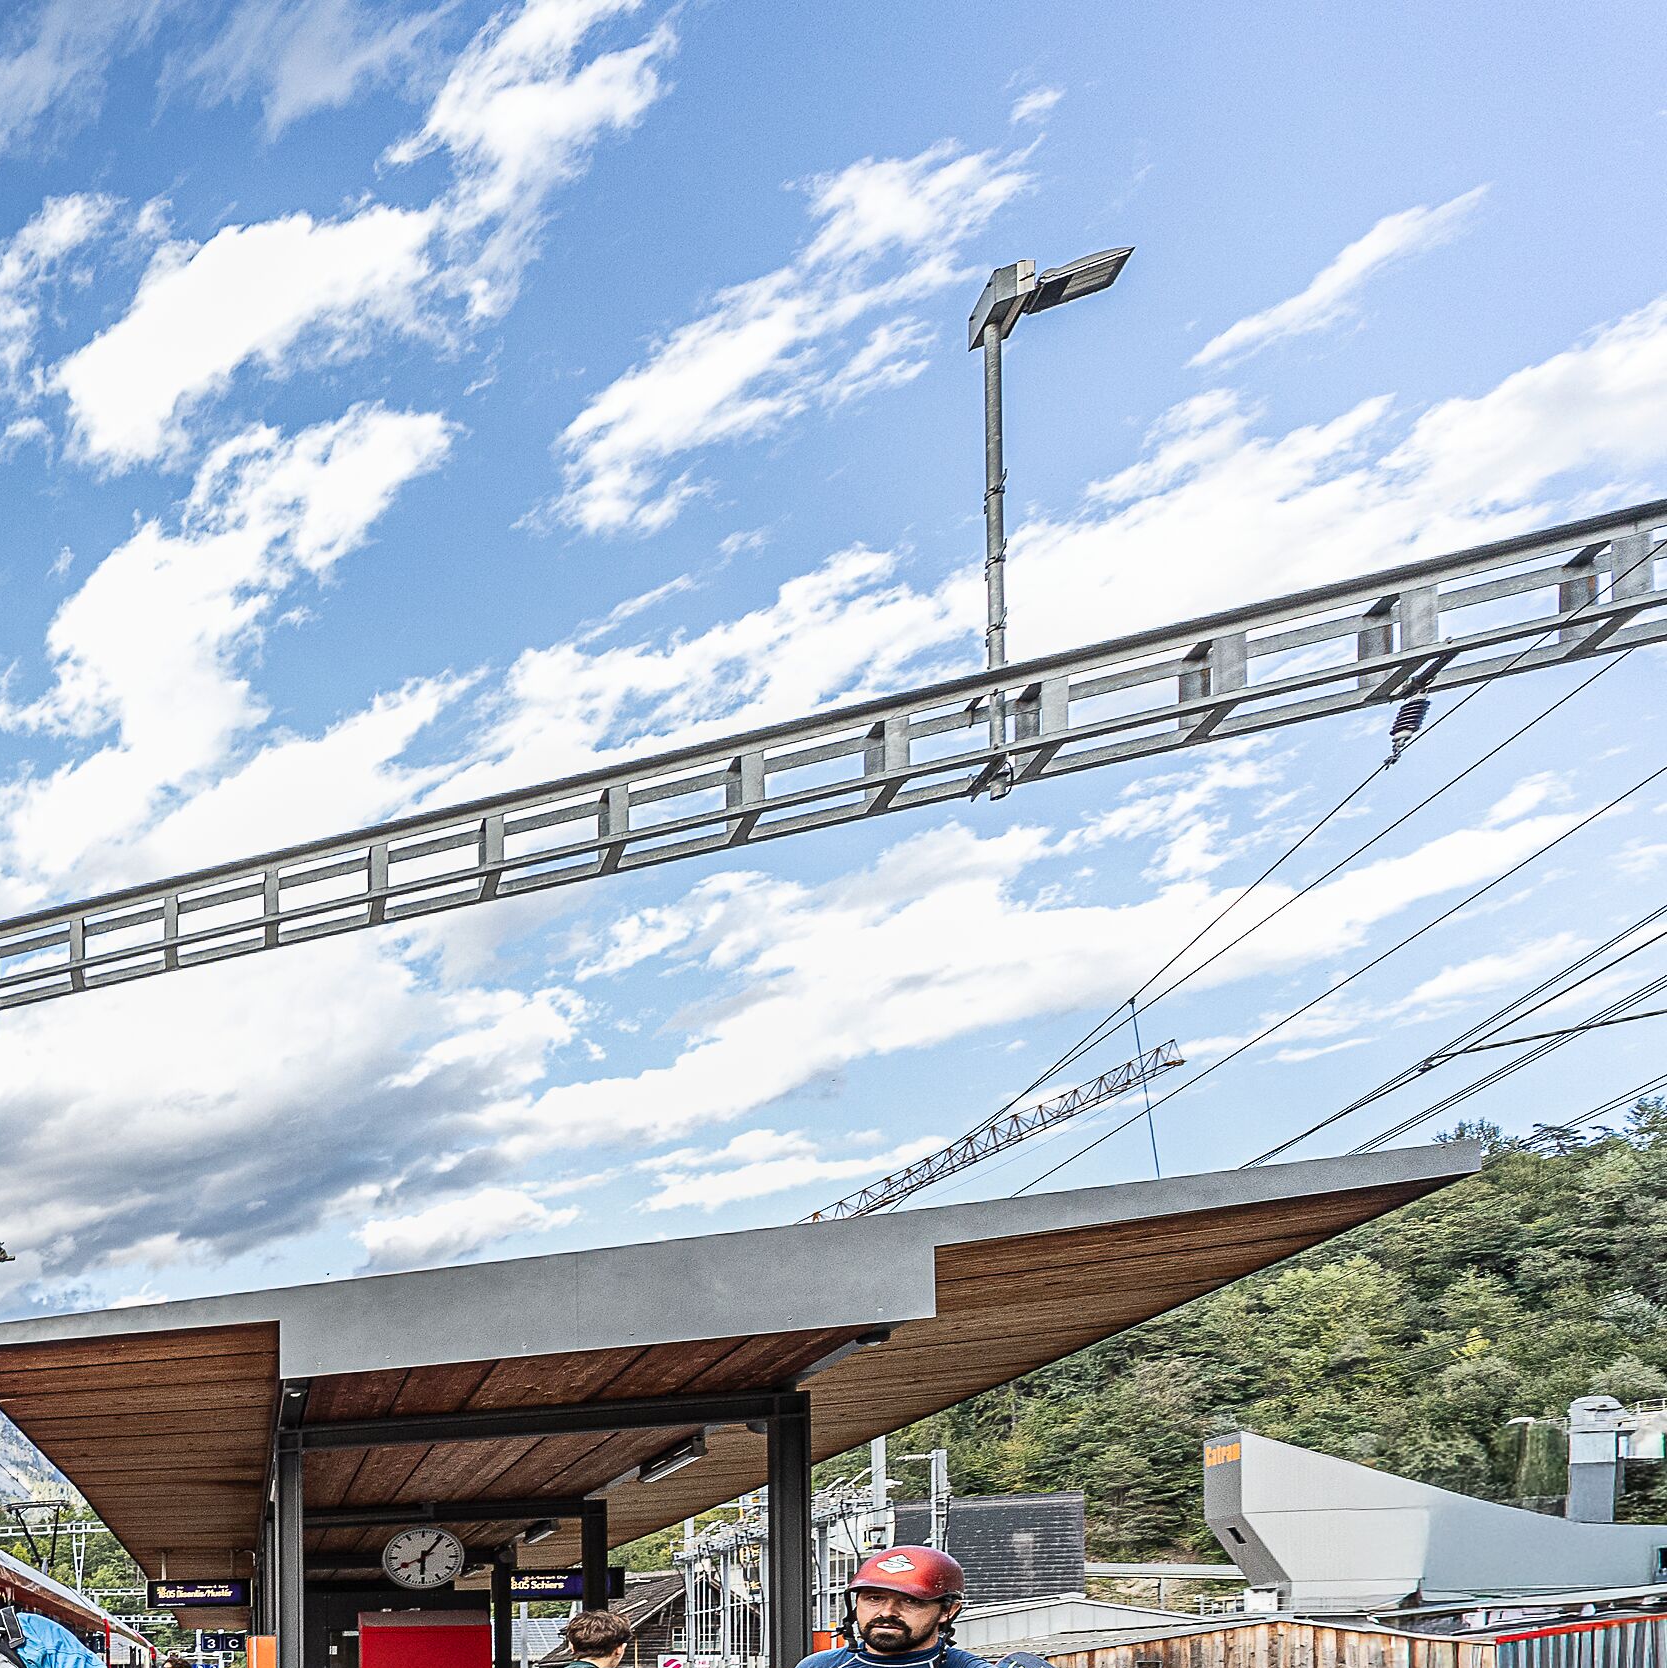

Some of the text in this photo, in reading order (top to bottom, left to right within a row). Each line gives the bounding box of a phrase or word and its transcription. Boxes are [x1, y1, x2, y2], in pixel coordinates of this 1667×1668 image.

[510, 1580, 565, 1590] 8:05 Schiers
[207, 1639, 239, 1649] 3 C
